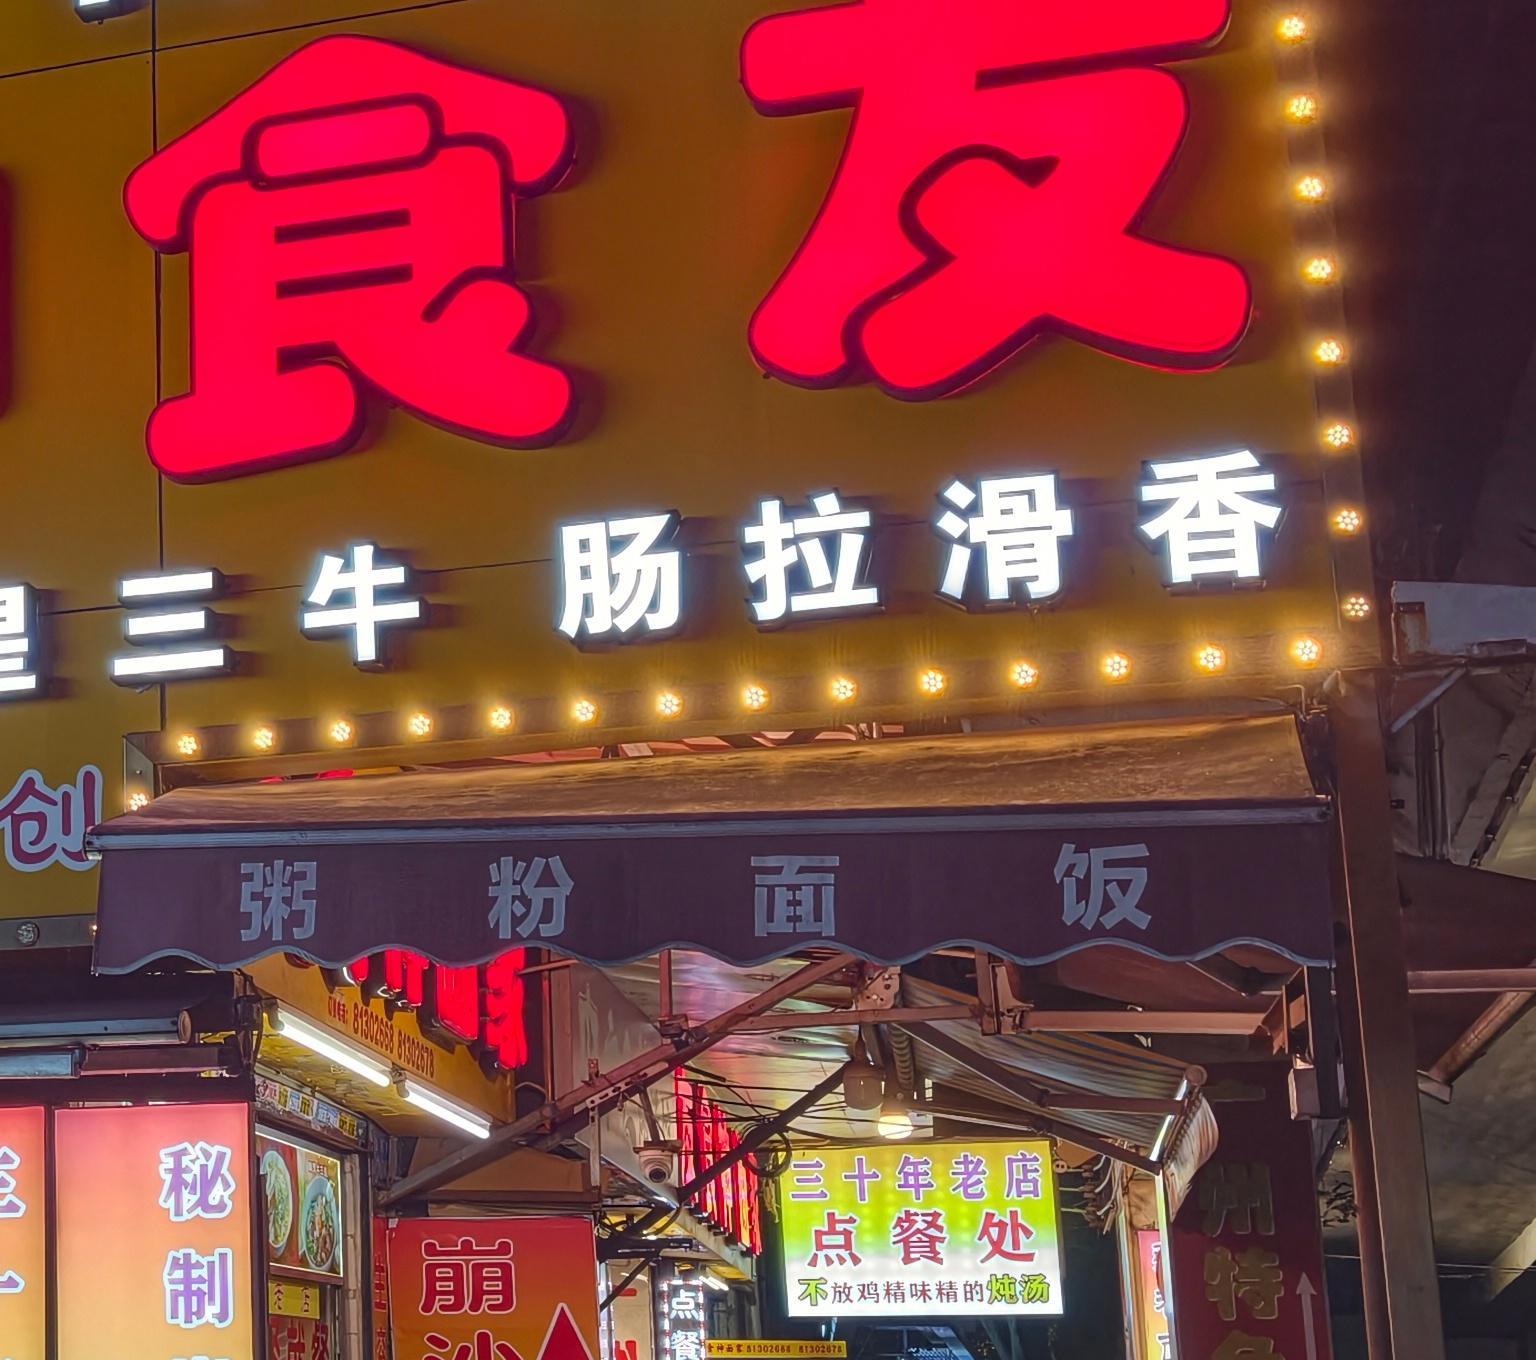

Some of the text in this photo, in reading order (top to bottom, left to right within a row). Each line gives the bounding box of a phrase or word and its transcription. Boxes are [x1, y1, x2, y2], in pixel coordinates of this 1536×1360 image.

[556, 448, 1285, 640] 香滑拉肠
[240, 842, 1152, 942] 粥粉面饭
[397, 1029, 435, 1078] 81302678
[789, 1152, 1043, 1202] 三十年老店
[806, 1209, 1037, 1268] 点餐处
[797, 1273, 1051, 1307] 不放鸡精味精的炖汤
